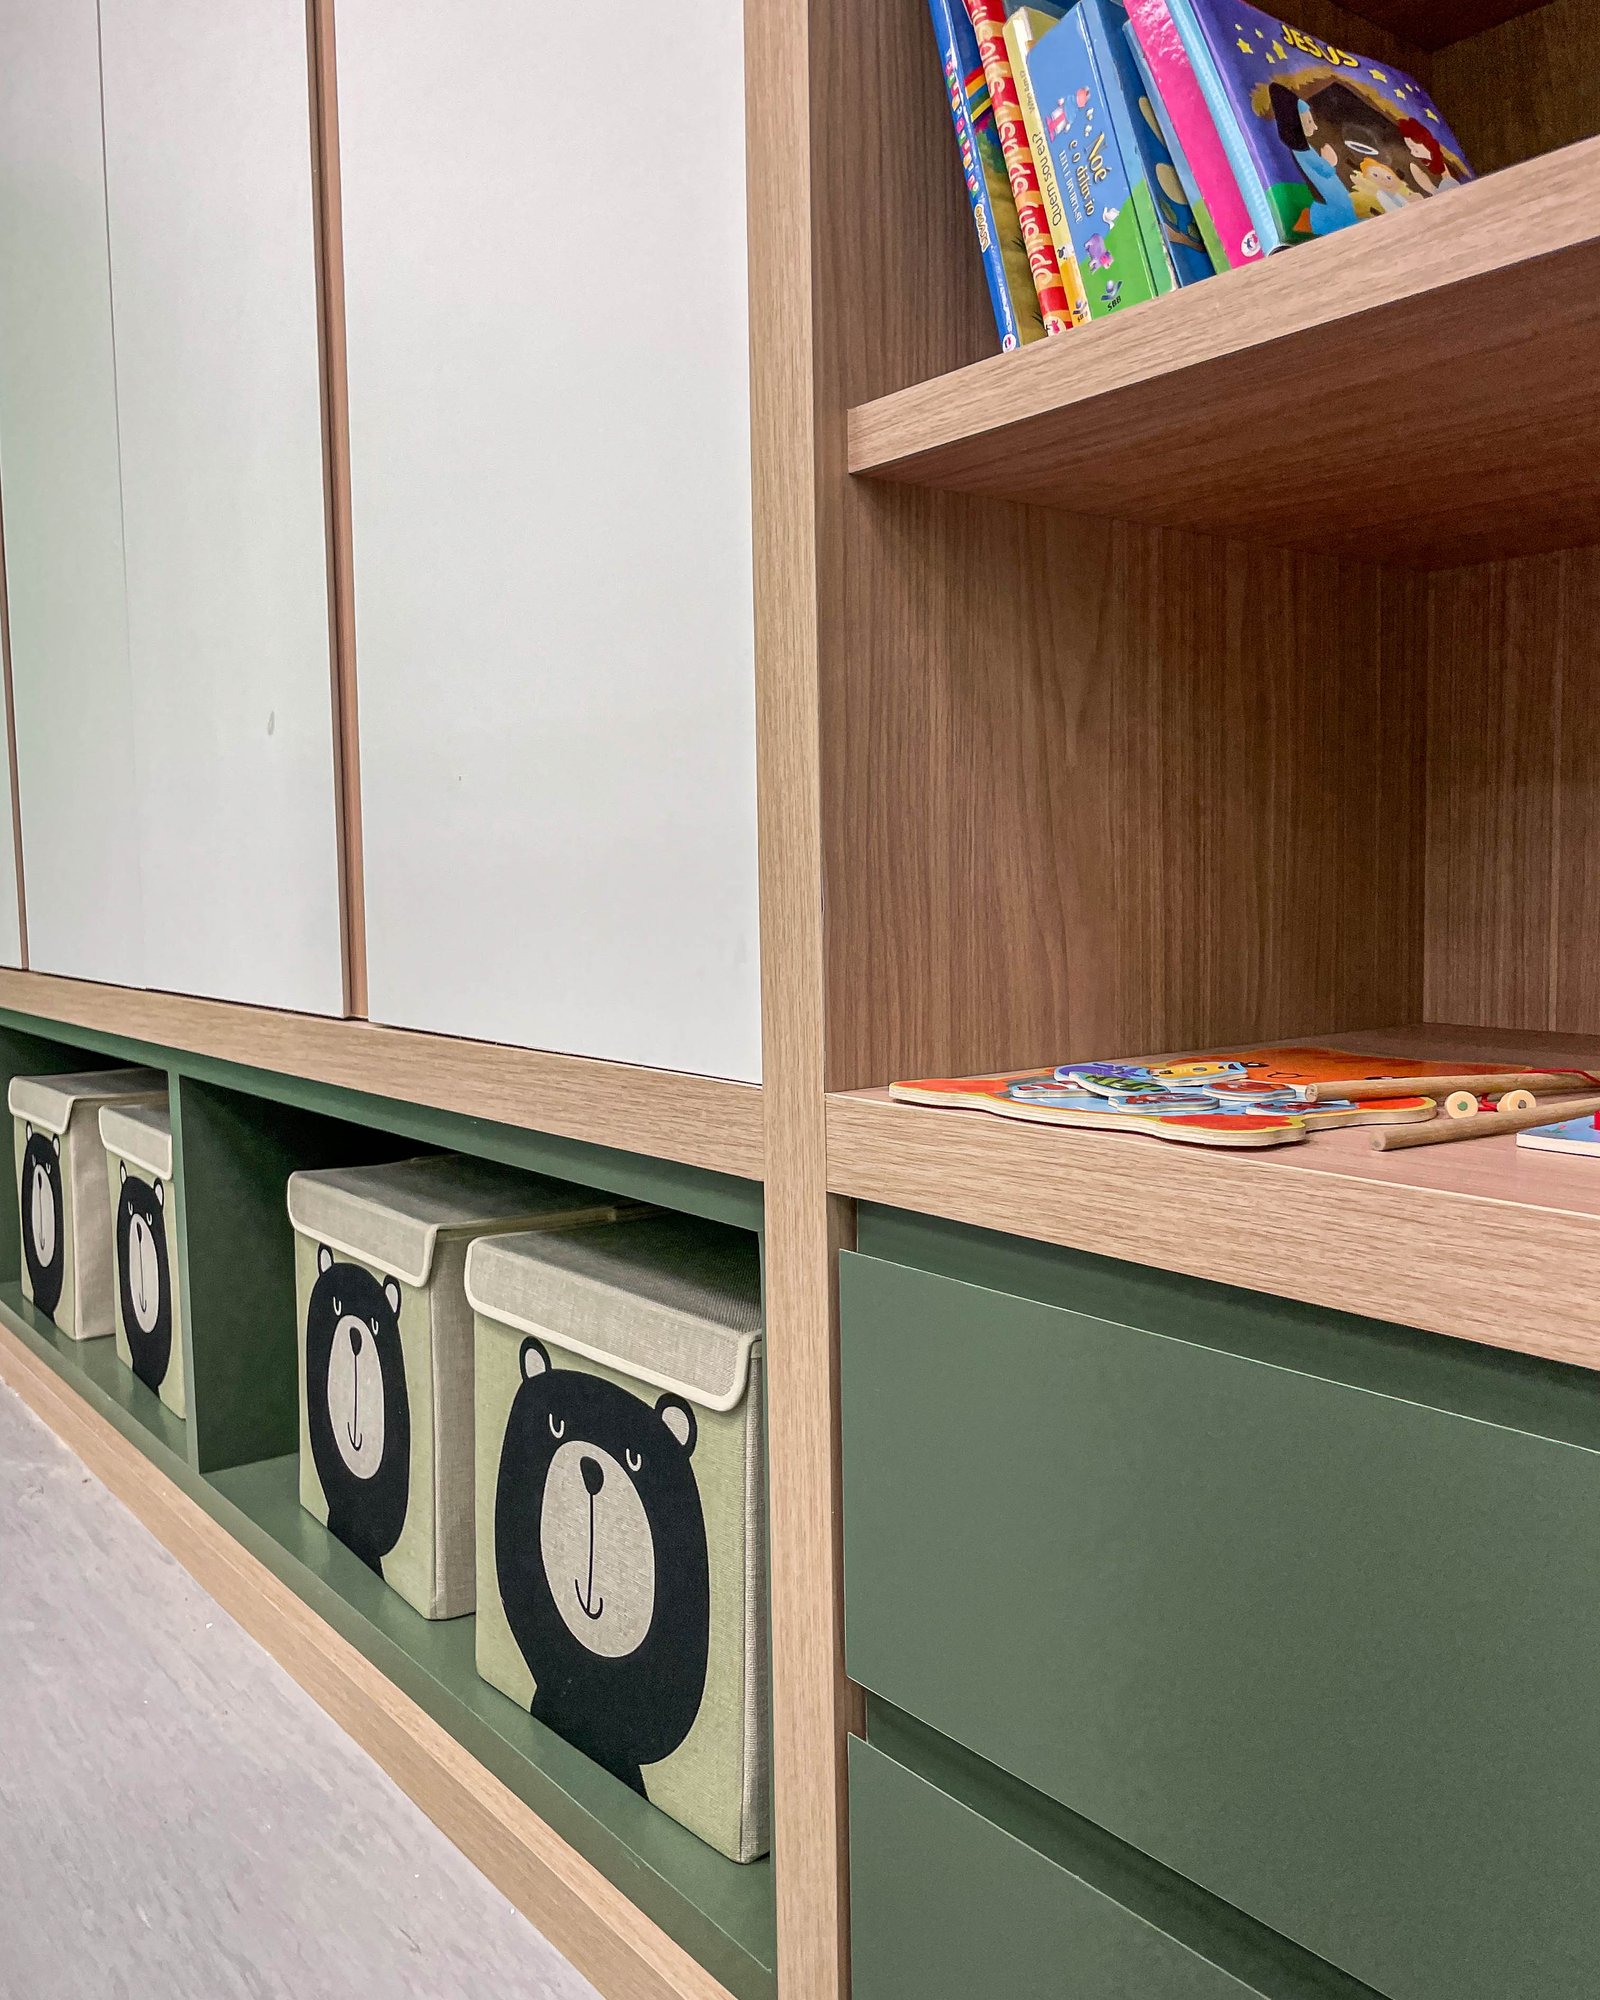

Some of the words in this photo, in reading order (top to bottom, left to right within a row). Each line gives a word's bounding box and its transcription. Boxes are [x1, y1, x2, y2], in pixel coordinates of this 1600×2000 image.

[1281, 24, 1359, 68] JESUS
[1032, 132, 1045, 156] eu?
[1069, 139, 1079, 150] e
[1040, 156, 1052, 182] sou
[1073, 152, 1081, 163] o
[1084, 131, 1113, 184] Noé
[1076, 165, 1096, 216] dilúvio
[1046, 182, 1062, 226] Quem
[1107, 295, 1122, 312] SBB
